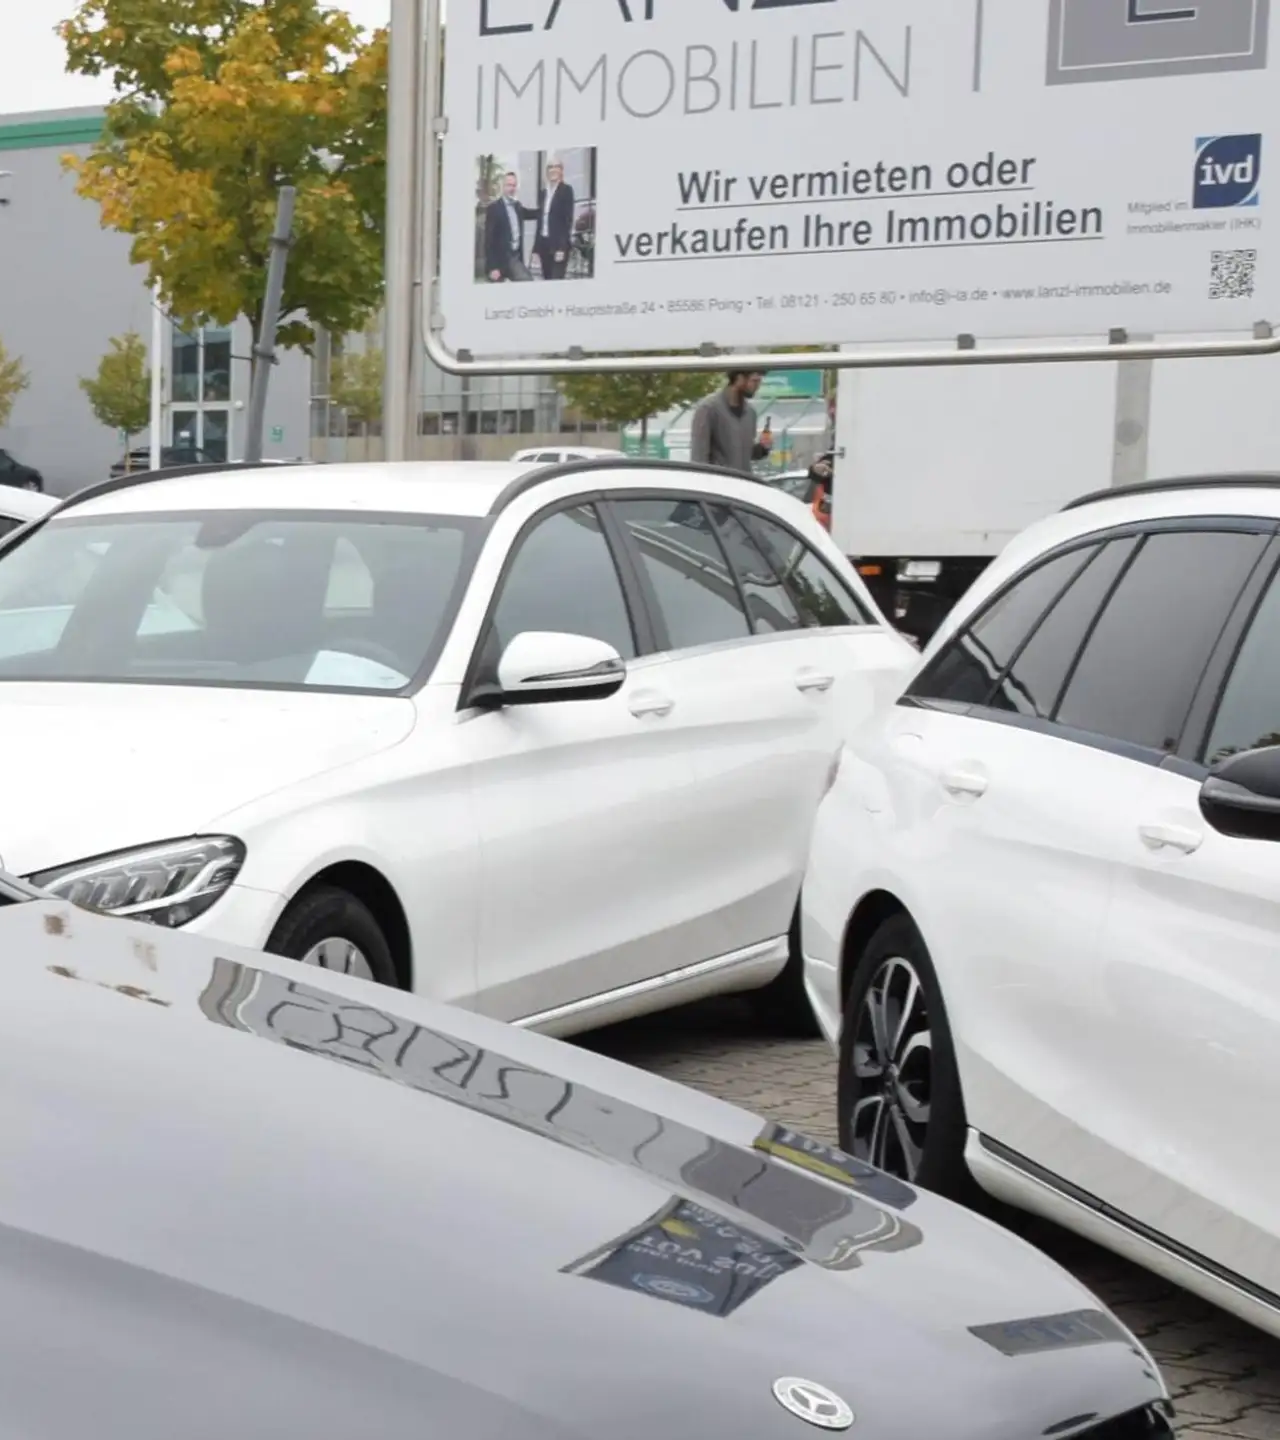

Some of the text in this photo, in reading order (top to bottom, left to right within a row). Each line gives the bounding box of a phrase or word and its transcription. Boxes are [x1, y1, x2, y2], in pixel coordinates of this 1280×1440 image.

[477, 25, 912, 131] IMMOBILIEN
[677, 152, 1037, 204] Wir vermieten oder
[1198, 153, 1254, 186] ivd
[614, 202, 1104, 259] verkaufen Ihre Immobilien
[484, 306, 514, 320] Lanzl
[516, 304, 555, 319] GmbH
[565, 302, 638, 319] Hauptstraße
[708, 298, 744, 313] Poing
